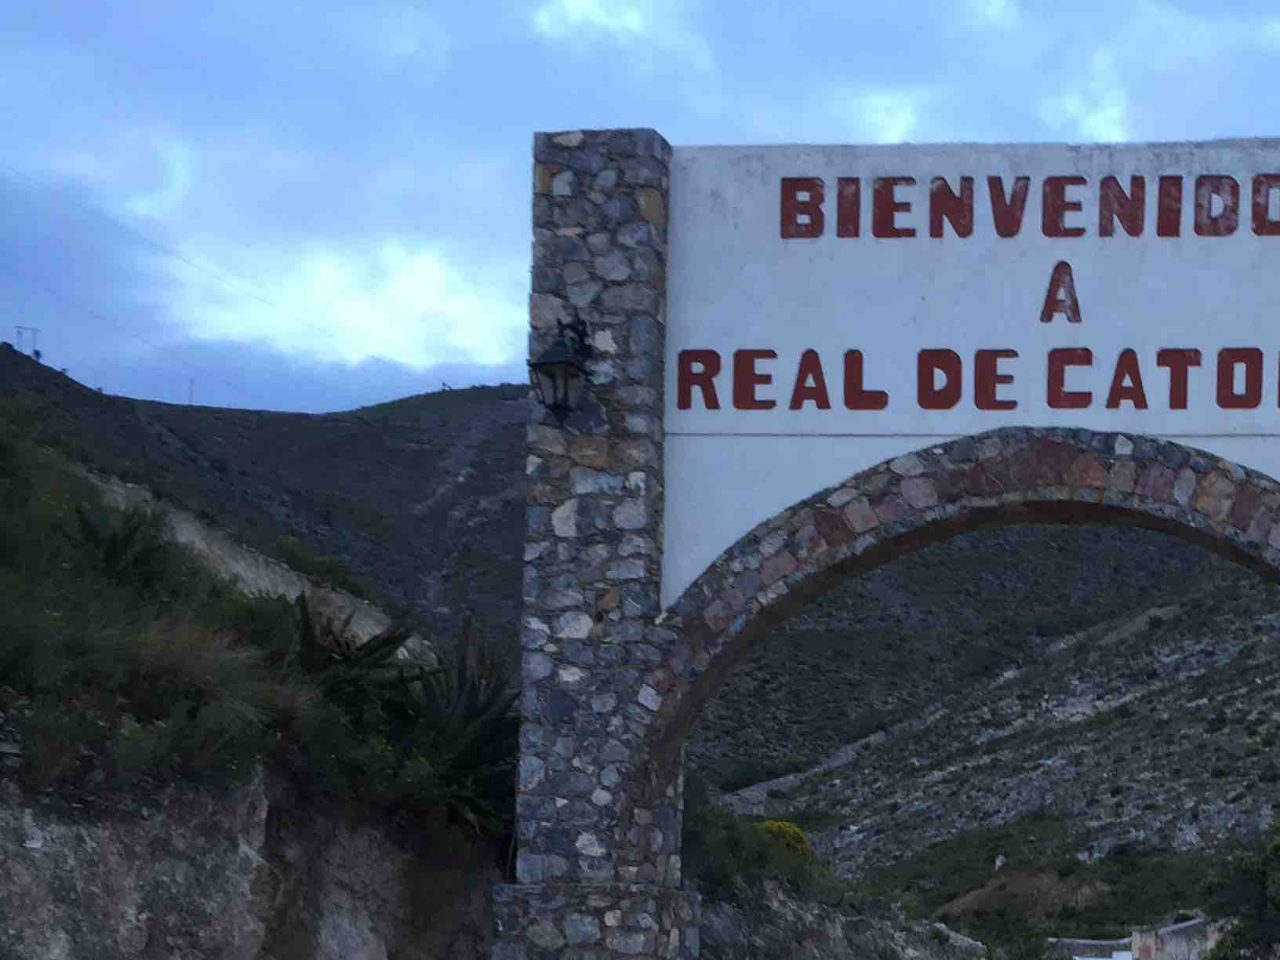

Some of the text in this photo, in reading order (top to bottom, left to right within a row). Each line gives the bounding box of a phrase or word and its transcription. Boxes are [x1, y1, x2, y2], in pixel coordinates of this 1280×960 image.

[1040, 260, 1082, 323] A
[677, 349, 889, 411] REAL
[916, 349, 1019, 411] DE
